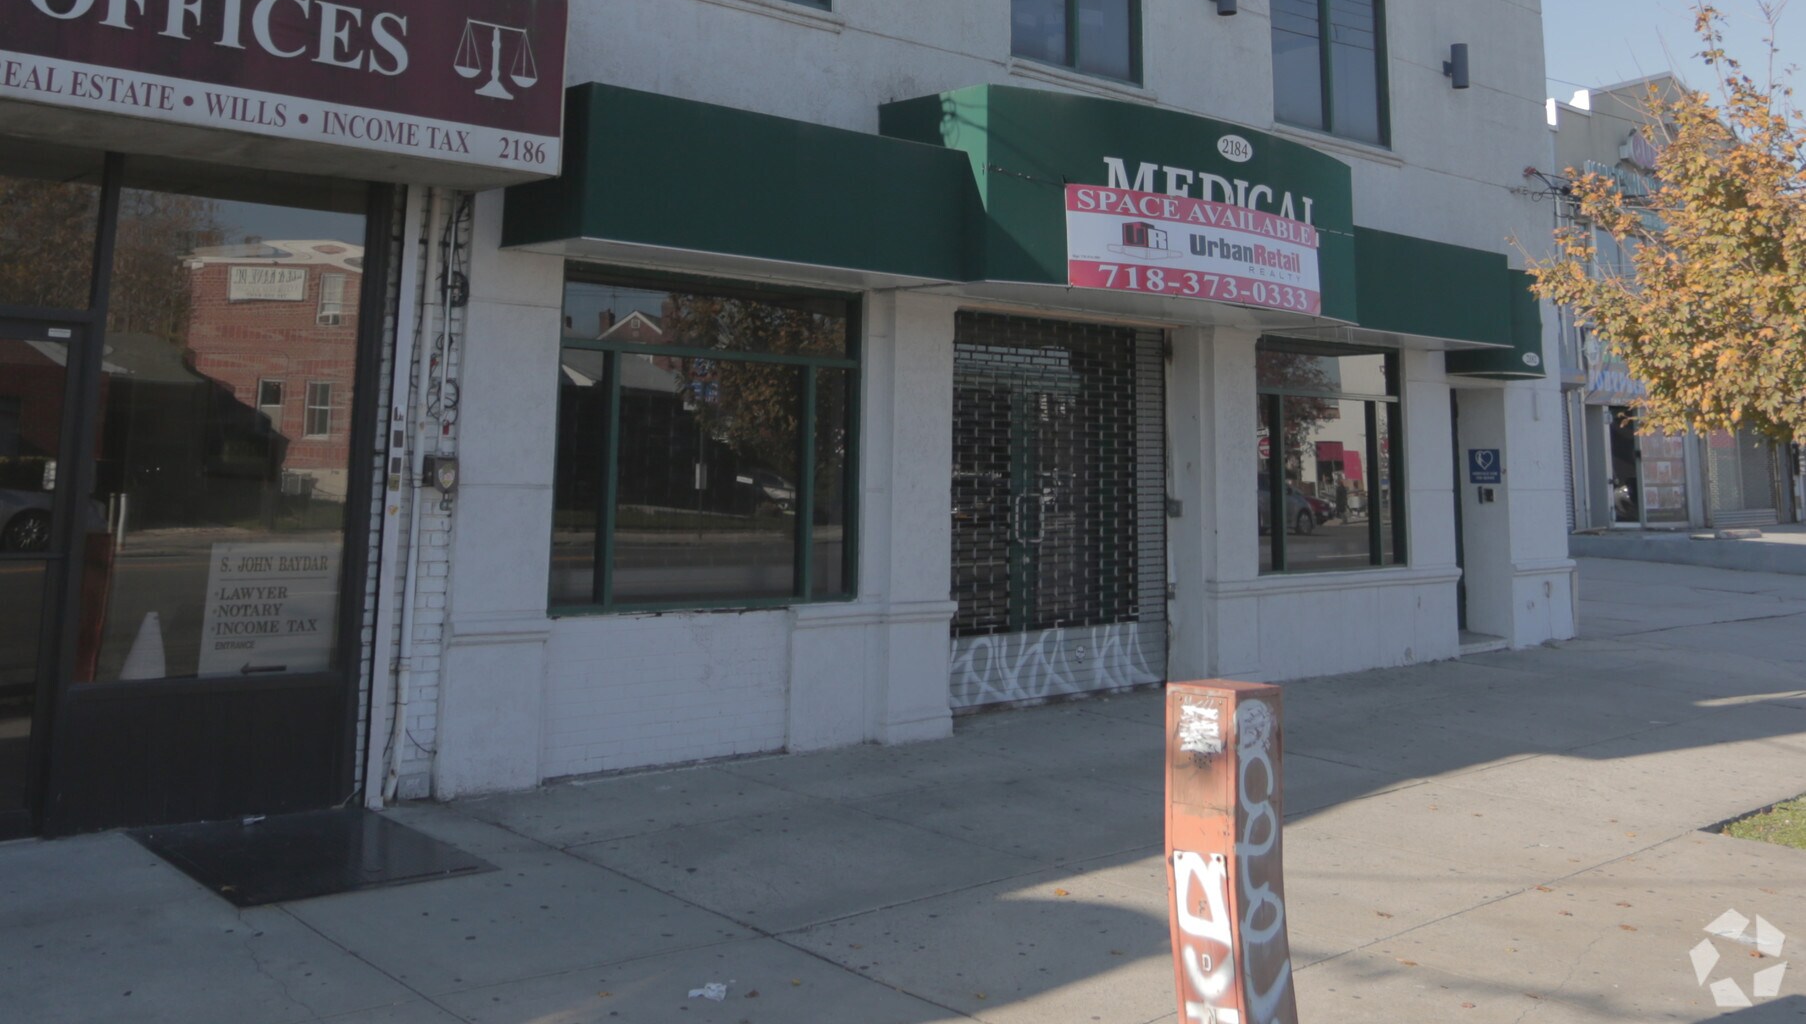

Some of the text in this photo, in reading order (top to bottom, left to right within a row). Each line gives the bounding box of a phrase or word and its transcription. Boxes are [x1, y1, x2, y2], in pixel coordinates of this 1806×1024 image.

[0, 59, 547, 165] EAL ESTATE WILLS INCOME TAX 2186
[1221, 138, 1249, 158] 2184
[1076, 188, 1313, 246] SPACE AVAILABLE
[1248, 266, 1301, 281] REALTY
[1098, 264, 1308, 311] 718-373-0333
[220, 556, 233, 573] S.
[238, 556, 273, 573] JOHN
[219, 586, 289, 601] LAWYER
[217, 603, 284, 618] NOTARY
[215, 618, 319, 635] INCOME TAX
